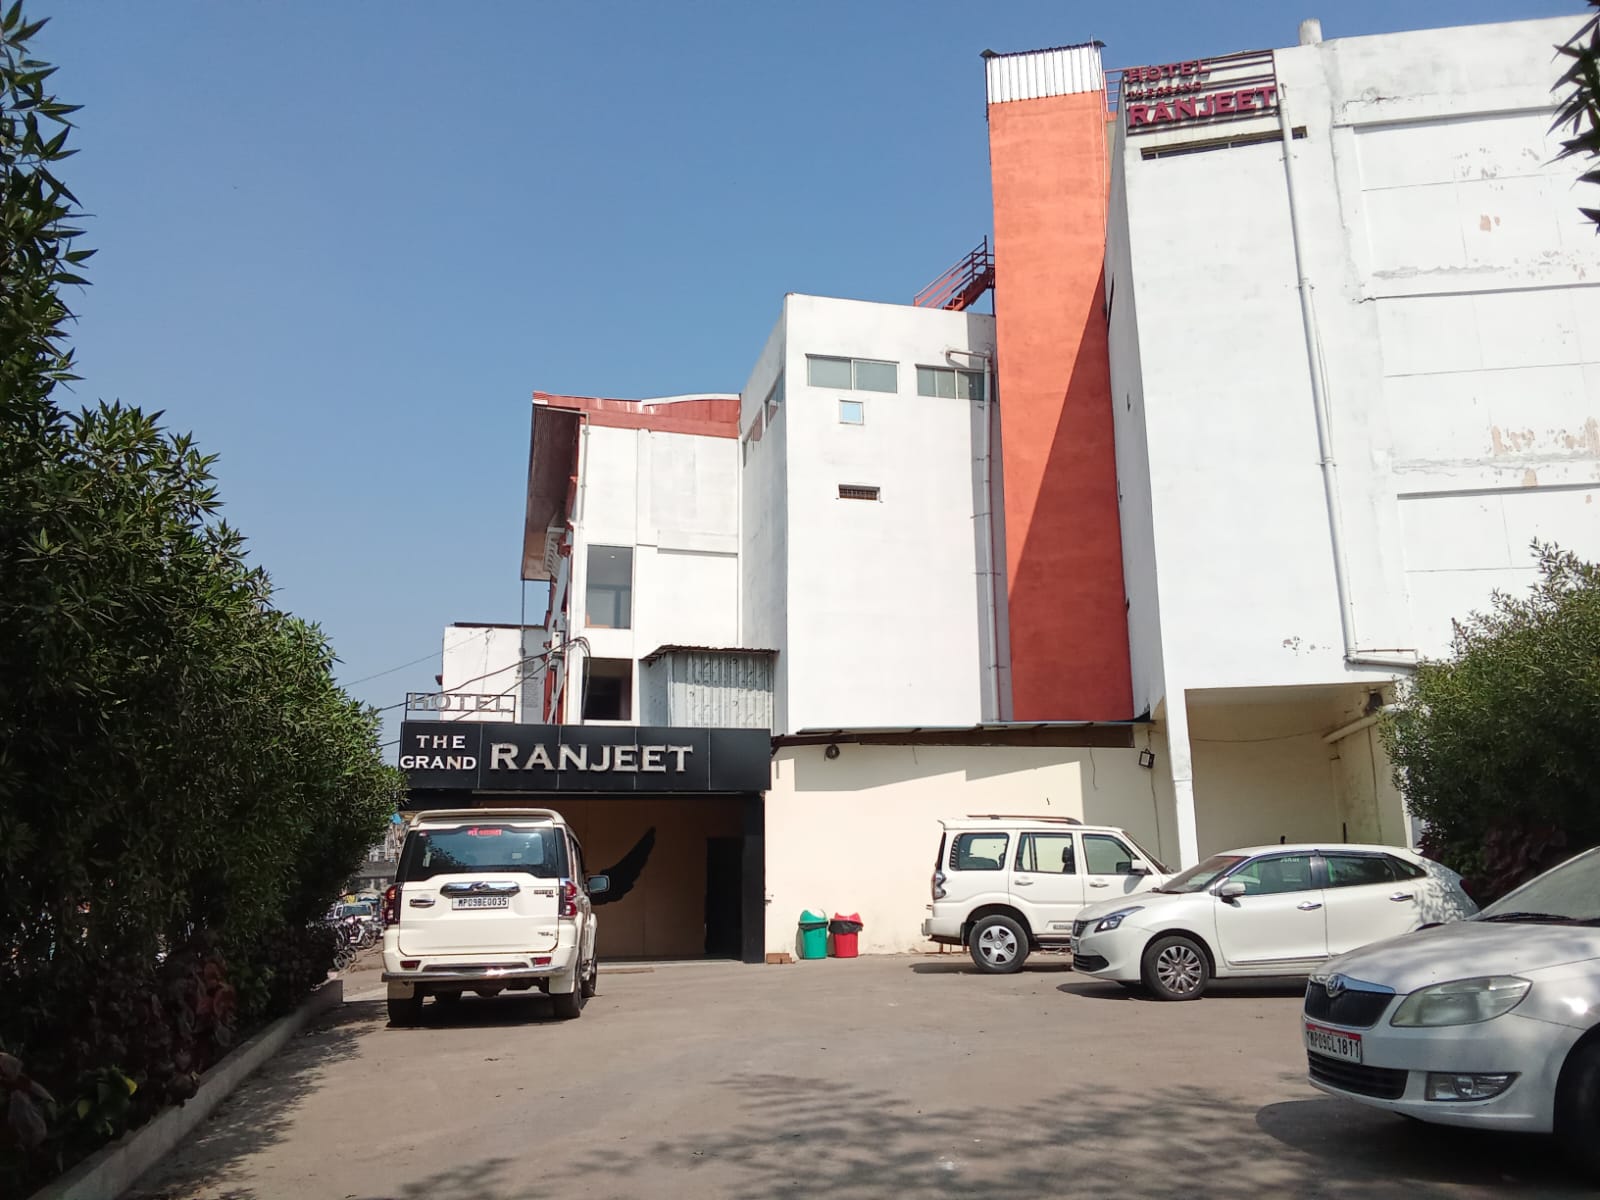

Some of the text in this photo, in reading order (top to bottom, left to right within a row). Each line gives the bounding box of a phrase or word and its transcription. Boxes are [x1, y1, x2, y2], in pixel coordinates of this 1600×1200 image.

[1127, 60, 1211, 83] HOTEL
[1128, 86, 1276, 126] RANJEET
[410, 693, 511, 712] HOTEL
[416, 735, 466, 750] THE
[400, 755, 477, 770] GRAND
[489, 742, 693, 773] RANJEET
